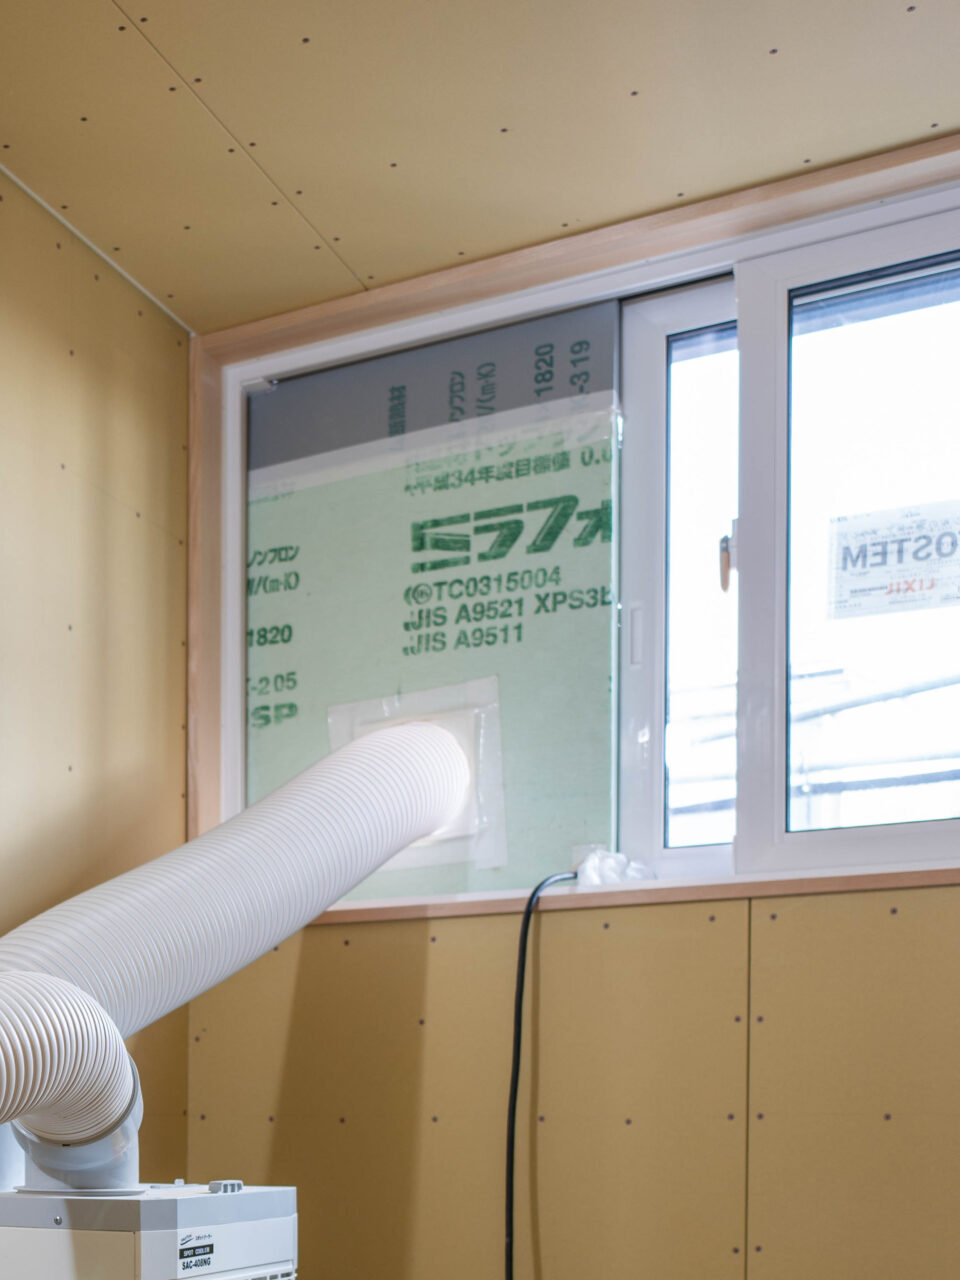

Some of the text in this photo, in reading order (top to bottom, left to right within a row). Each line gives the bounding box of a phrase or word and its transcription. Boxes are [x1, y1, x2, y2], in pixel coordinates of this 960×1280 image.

[534, 343, 555, 396] 1820
[455, 597, 524, 624] A9521
[247, 624, 294, 648] 1820
[453, 623, 524, 650] A9511
